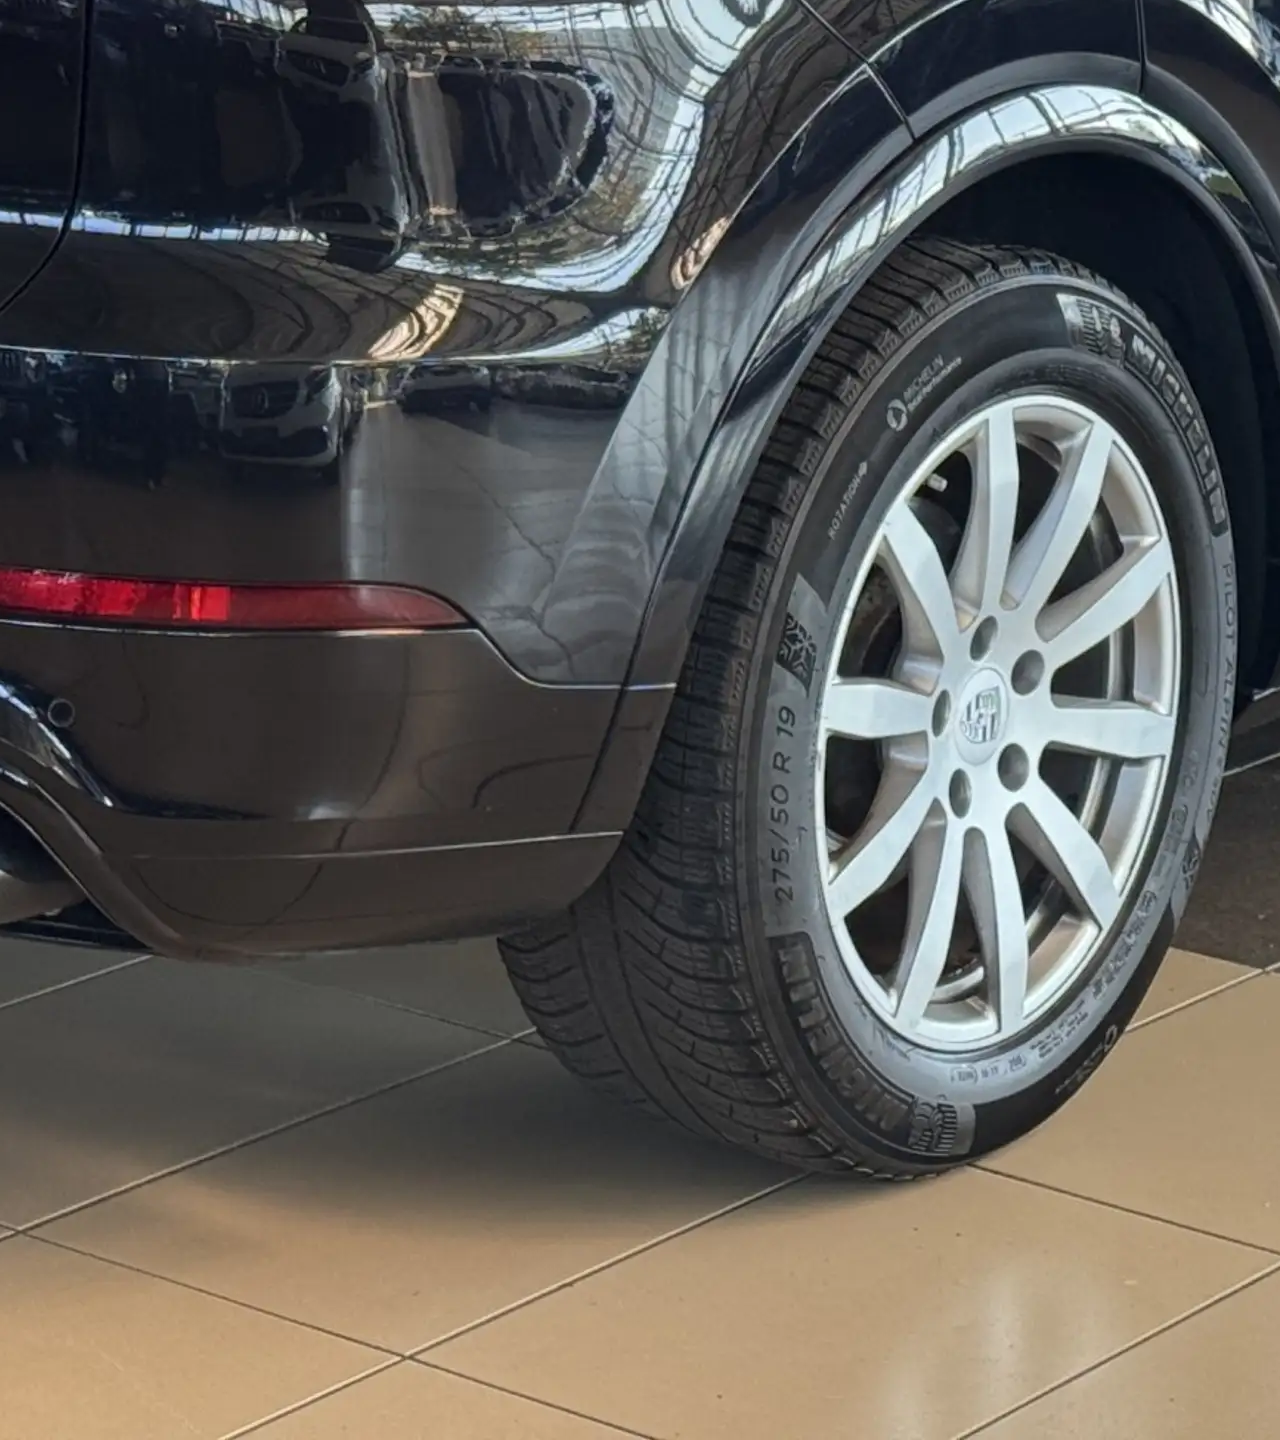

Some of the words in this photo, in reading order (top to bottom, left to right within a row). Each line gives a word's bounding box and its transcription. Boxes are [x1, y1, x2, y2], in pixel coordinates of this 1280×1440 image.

[903, 353, 944, 402] MICHELIN
[1129, 333, 1227, 525] MICHELIN
[827, 473, 861, 541] ROTATION
[1221, 561, 1237, 646] PILOT
[775, 705, 797, 739] 19
[1218, 662, 1235, 750] ALPIN
[772, 751, 792, 775] R
[768, 783, 794, 903] 275/50
[778, 945, 910, 1131] MICHELIN
